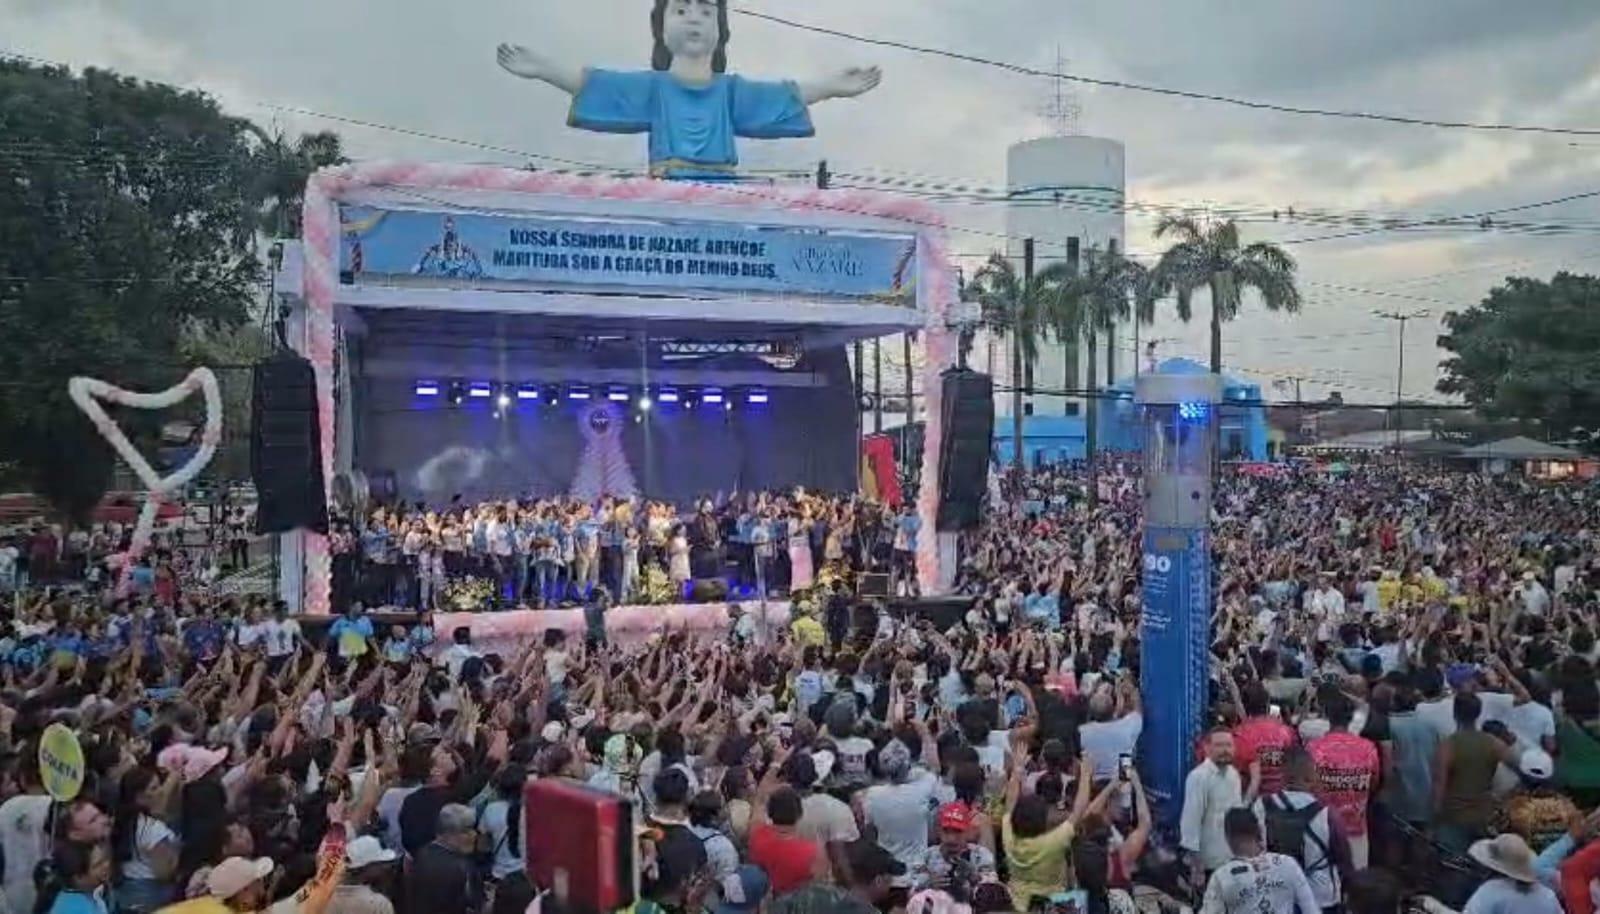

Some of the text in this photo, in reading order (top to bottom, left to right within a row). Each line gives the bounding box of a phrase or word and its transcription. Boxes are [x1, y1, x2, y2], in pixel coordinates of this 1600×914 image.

[510, 229, 557, 247] NOSSA
[561, 231, 626, 250] SENHORA
[629, 235, 645, 251] DE
[493, 250, 568, 268] MARITUBA
[571, 254, 600, 270] SOB
[603, 256, 613, 270] A
[665, 259, 684, 274] DO
[687, 259, 738, 276] MENINO
[41, 749, 77, 780] COLETA
